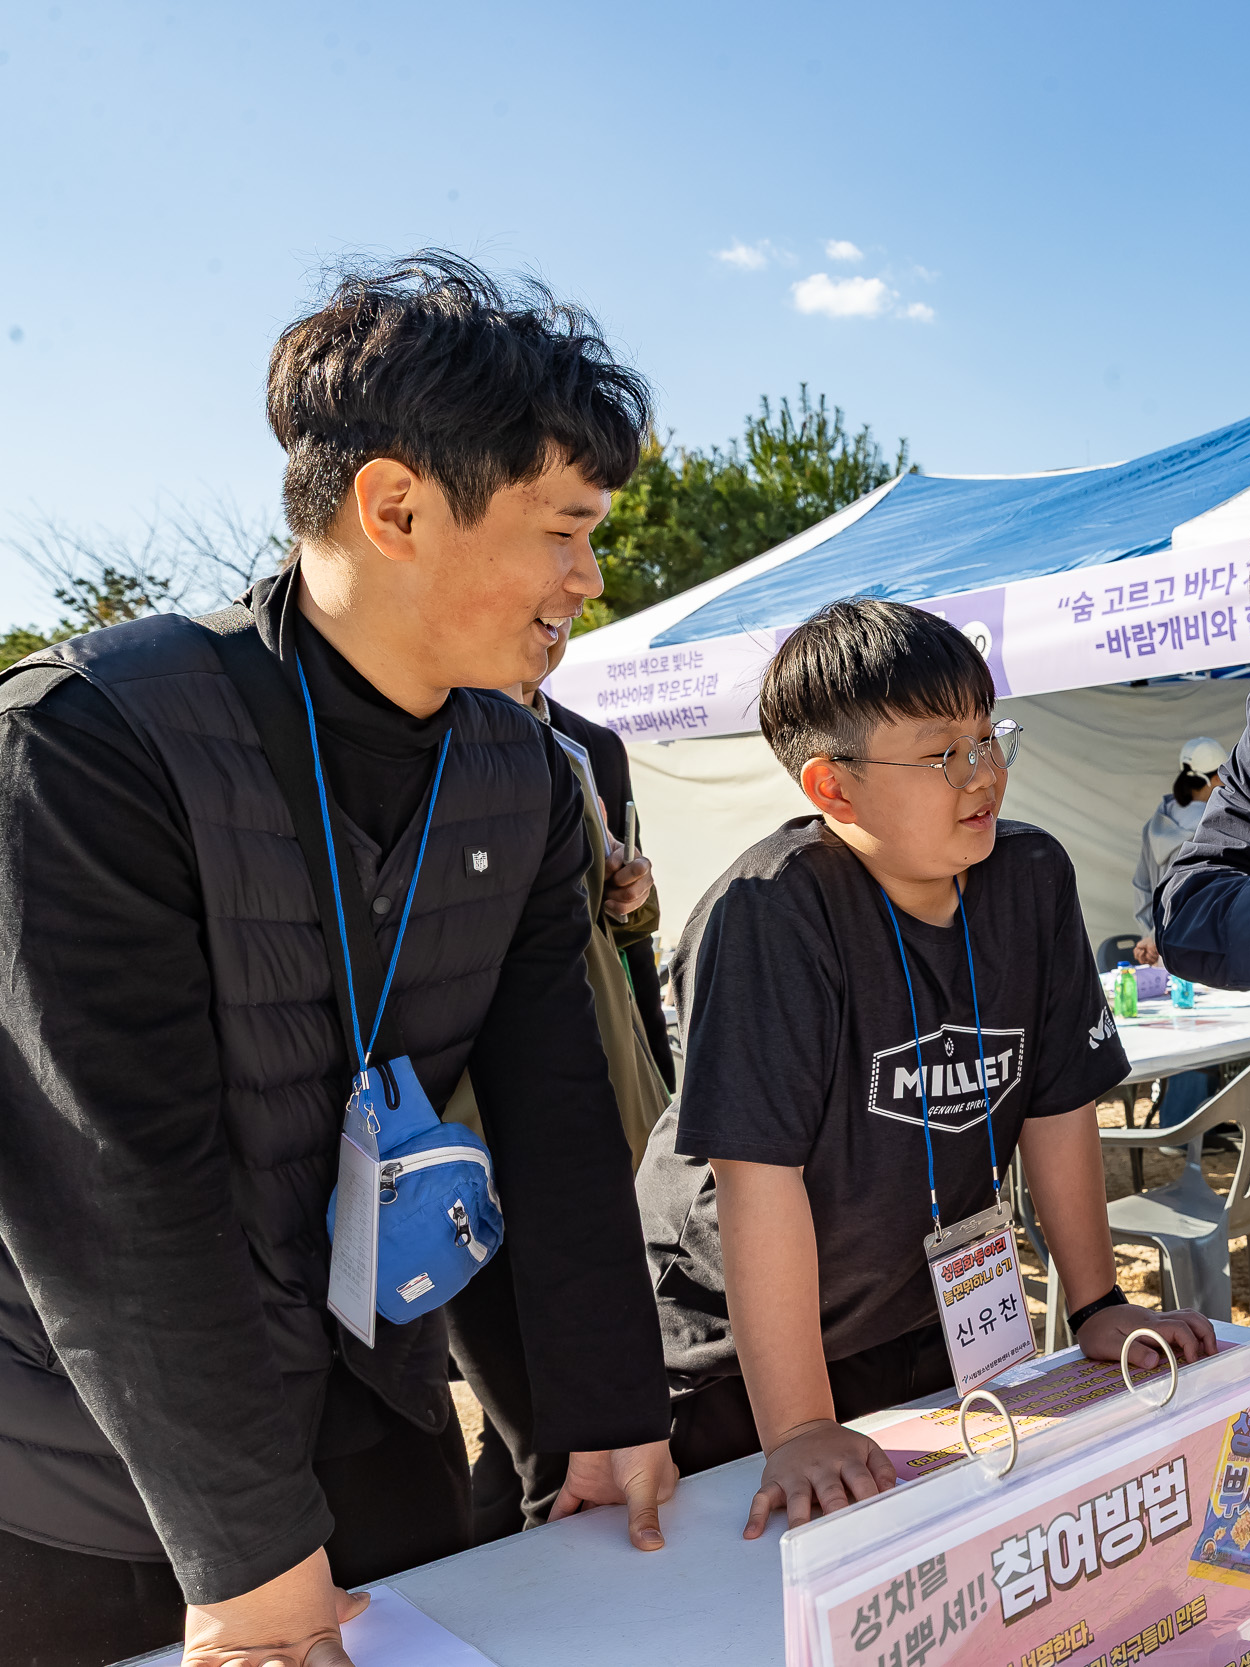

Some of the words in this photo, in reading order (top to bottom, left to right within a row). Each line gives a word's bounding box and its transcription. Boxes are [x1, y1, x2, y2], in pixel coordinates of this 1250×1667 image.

[1101, 576, 1176, 616] 고르고
[1183, 562, 1238, 601] 바다
[1095, 606, 1238, 659] -바람개비와
[606, 659, 637, 682] 각자의
[639, 654, 670, 677] 색으로
[672, 649, 704, 673] 빛나는
[597, 683, 655, 711] 아차산아래
[657, 672, 719, 702] 작은도서관
[893, 1048, 1013, 1099] MILLET
[927, 1101, 965, 1117] GENUINE
[941, 1236, 1007, 1283] 성문화동아리
[943, 1267, 994, 1307] 놀면뭐하니
[995, 1256, 1013, 1278] 6기
[992, 1455, 1192, 1627] 참여방법
[850, 1551, 949, 1652] 성차별
[1110, 1614, 1175, 1667] 친구들이
[1175, 1594, 1208, 1634] 만든
